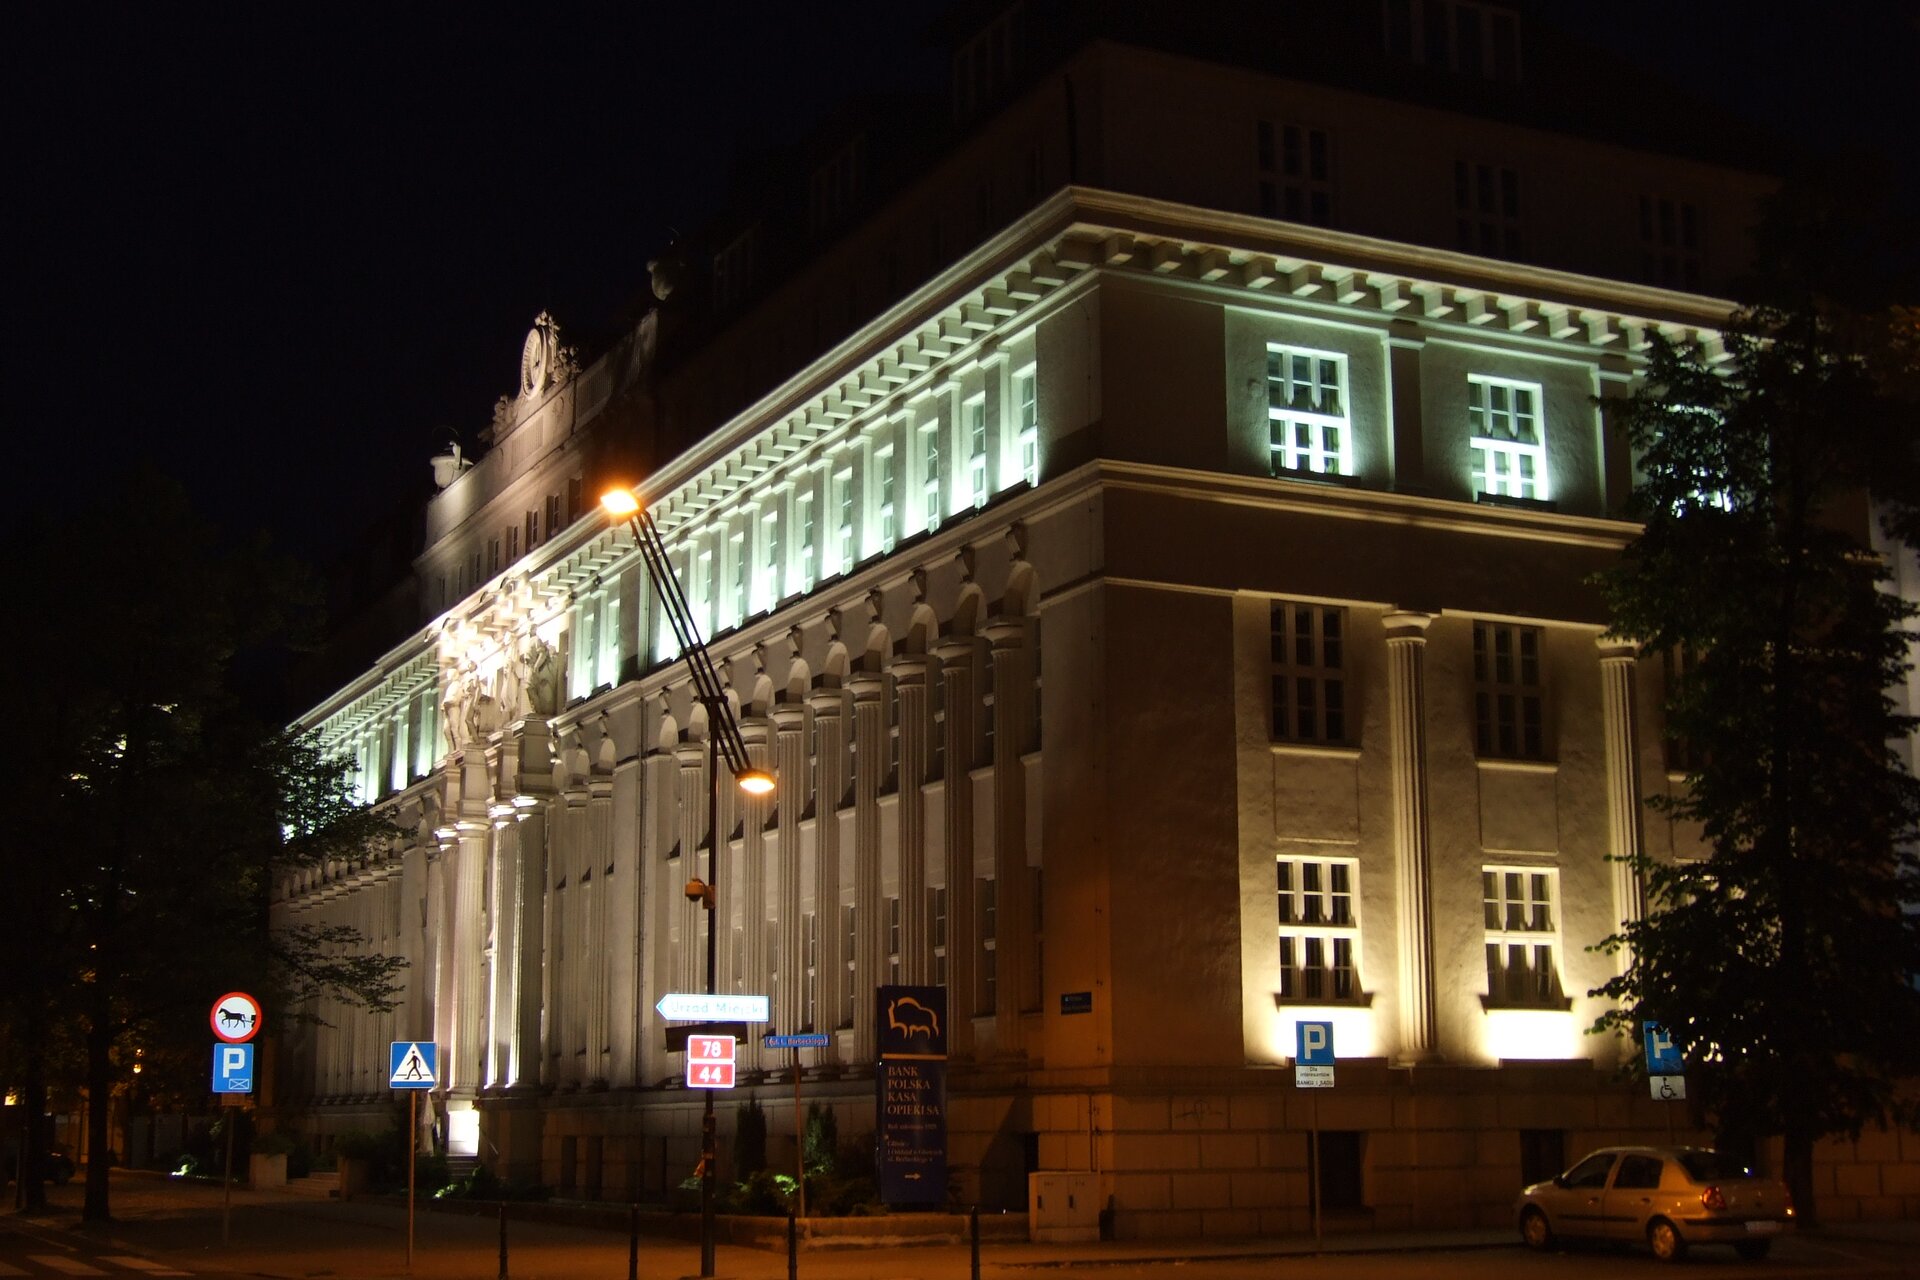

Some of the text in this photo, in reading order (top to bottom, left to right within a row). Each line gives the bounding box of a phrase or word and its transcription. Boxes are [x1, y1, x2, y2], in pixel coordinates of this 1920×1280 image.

[1304, 1024, 1326, 1059] P
[702, 1041, 722, 1057] 78
[222, 1048, 246, 1078] P
[699, 1066, 722, 1082] 44
[887, 1065, 918, 1077] BANK
[887, 1079, 931, 1089] POLSKA
[887, 1092, 917, 1102] KASA
[887, 1104, 925, 1115] OPIEKI
